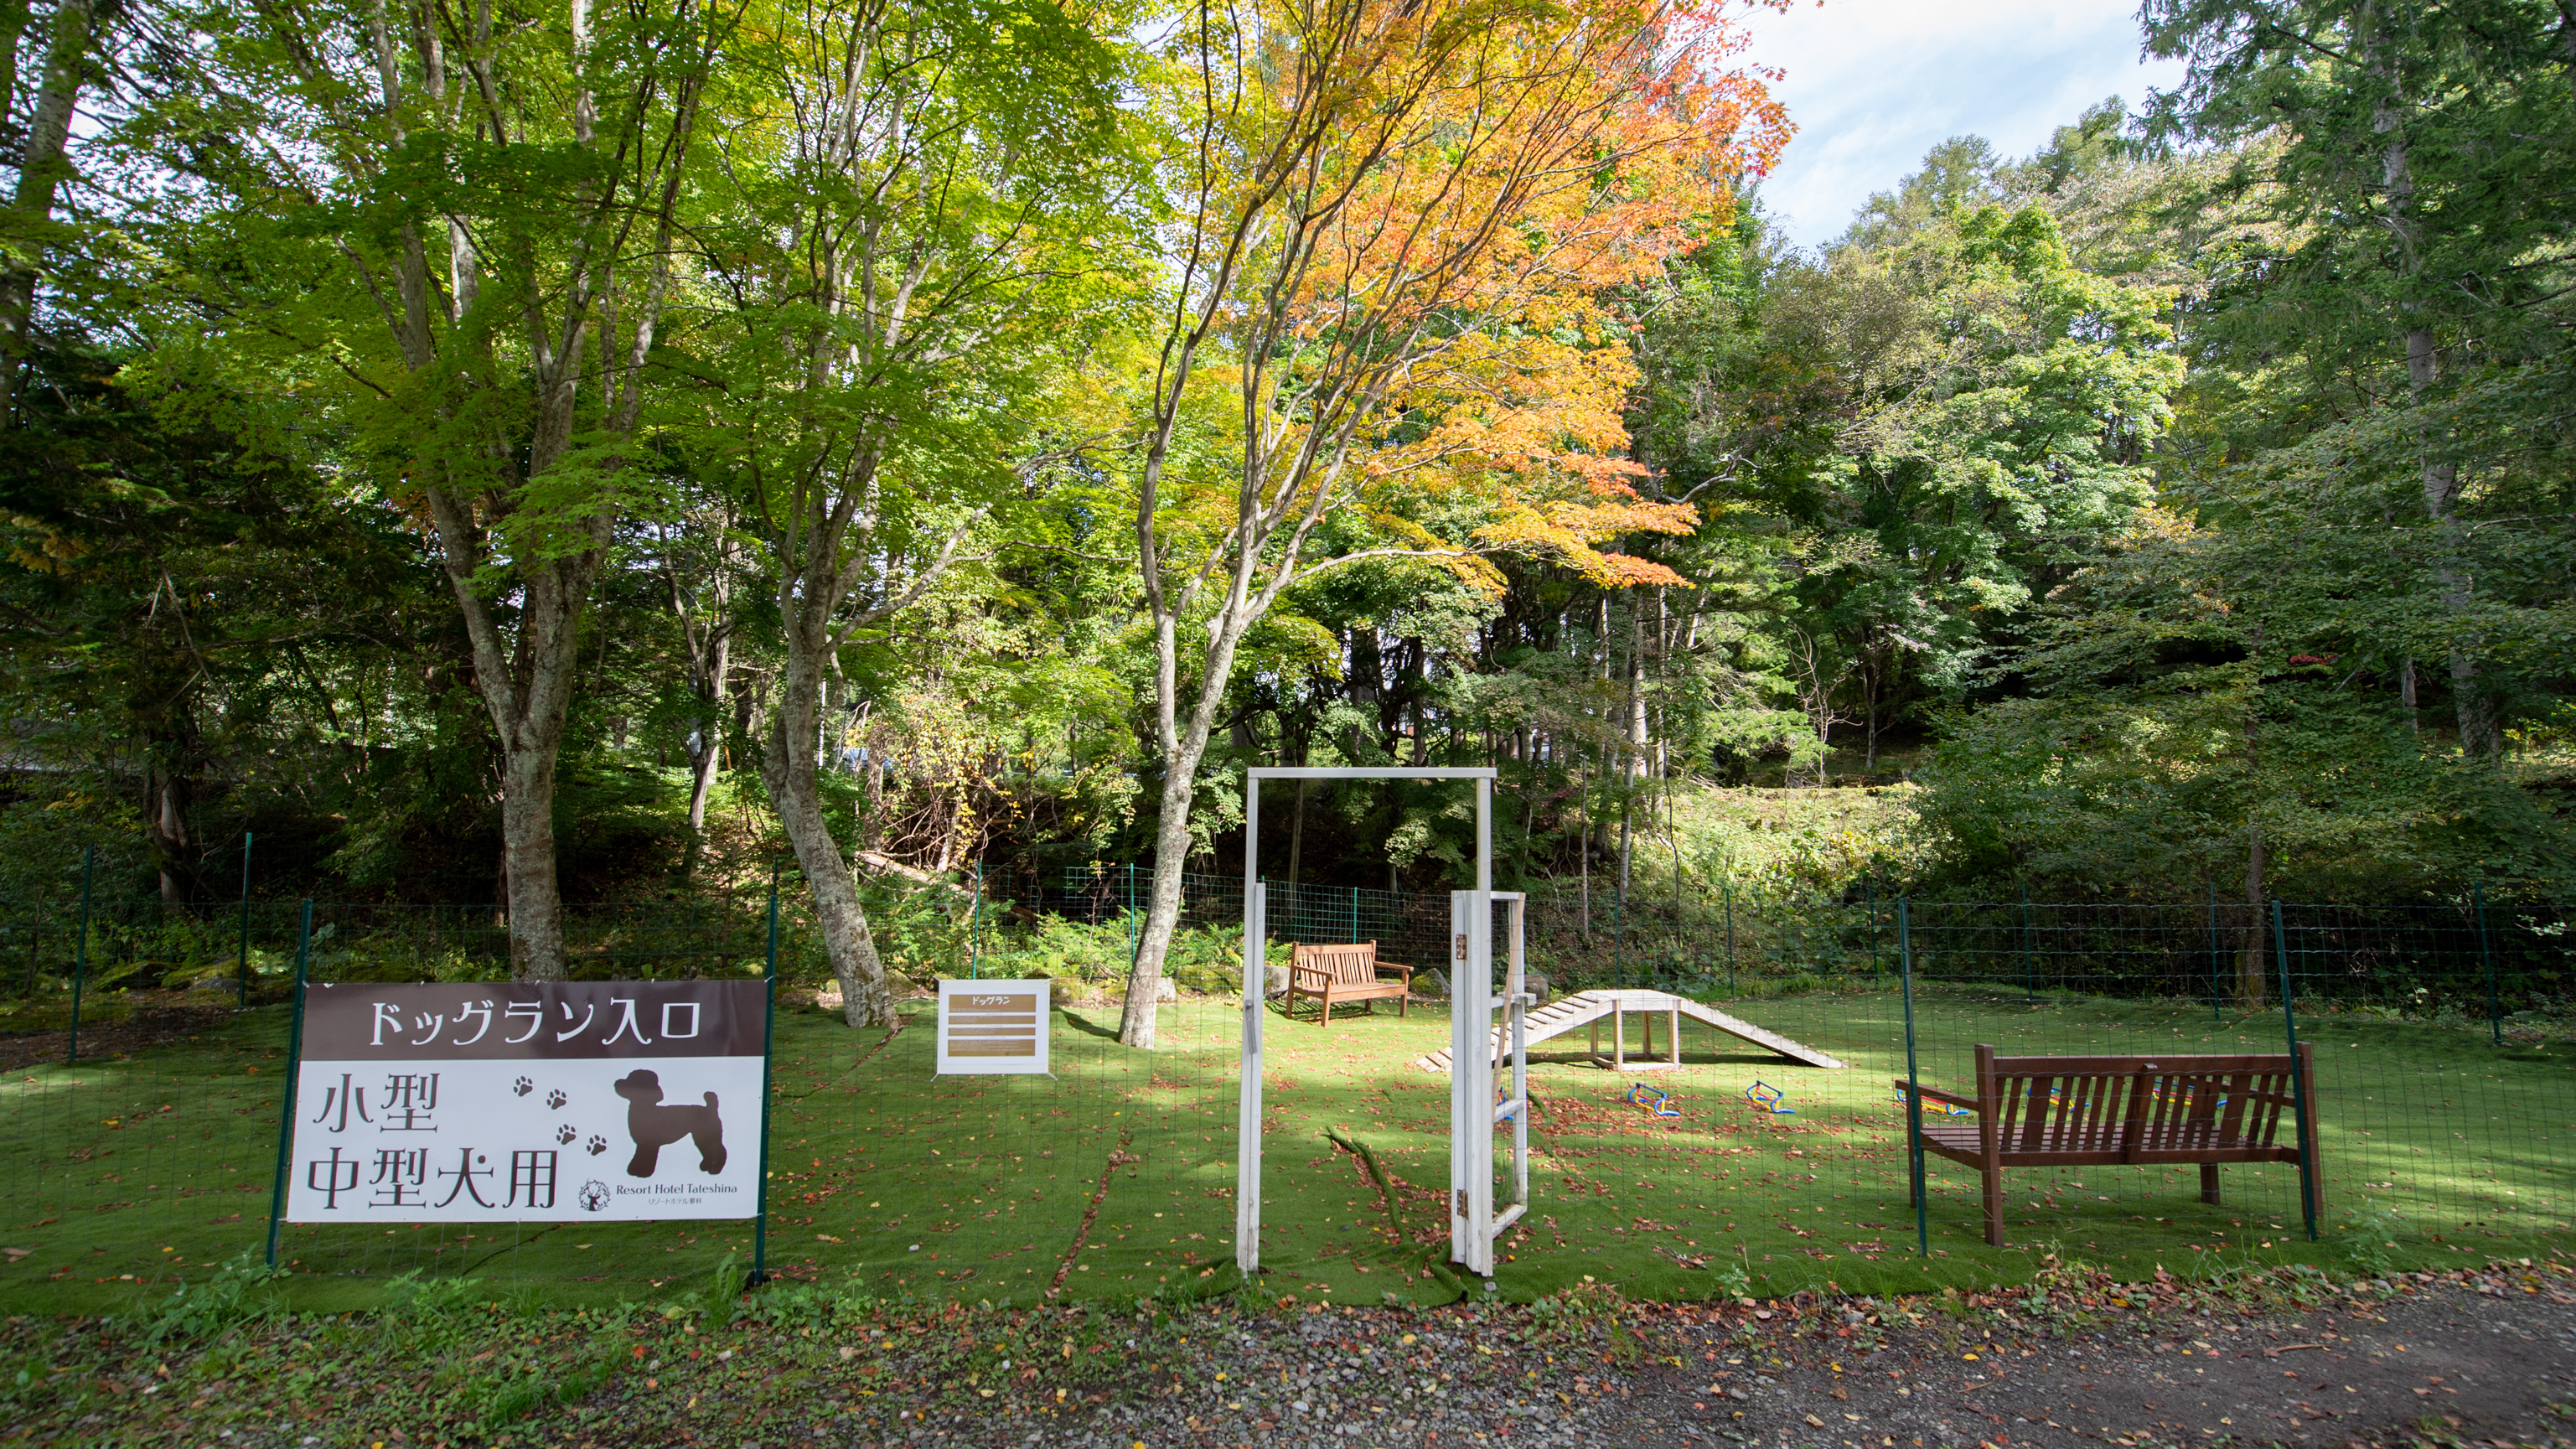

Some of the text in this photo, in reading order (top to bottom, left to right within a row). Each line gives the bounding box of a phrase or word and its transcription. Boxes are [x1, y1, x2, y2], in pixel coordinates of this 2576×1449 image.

[369, 996, 701, 1047] ドッグラン入口
[972, 996, 1011, 1006] ドッグラン
[313, 1072, 441, 1133] 小型
[307, 1146, 558, 1209] 中型犬用
[616, 1182, 737, 1195] Resort Hotel Tateshina
